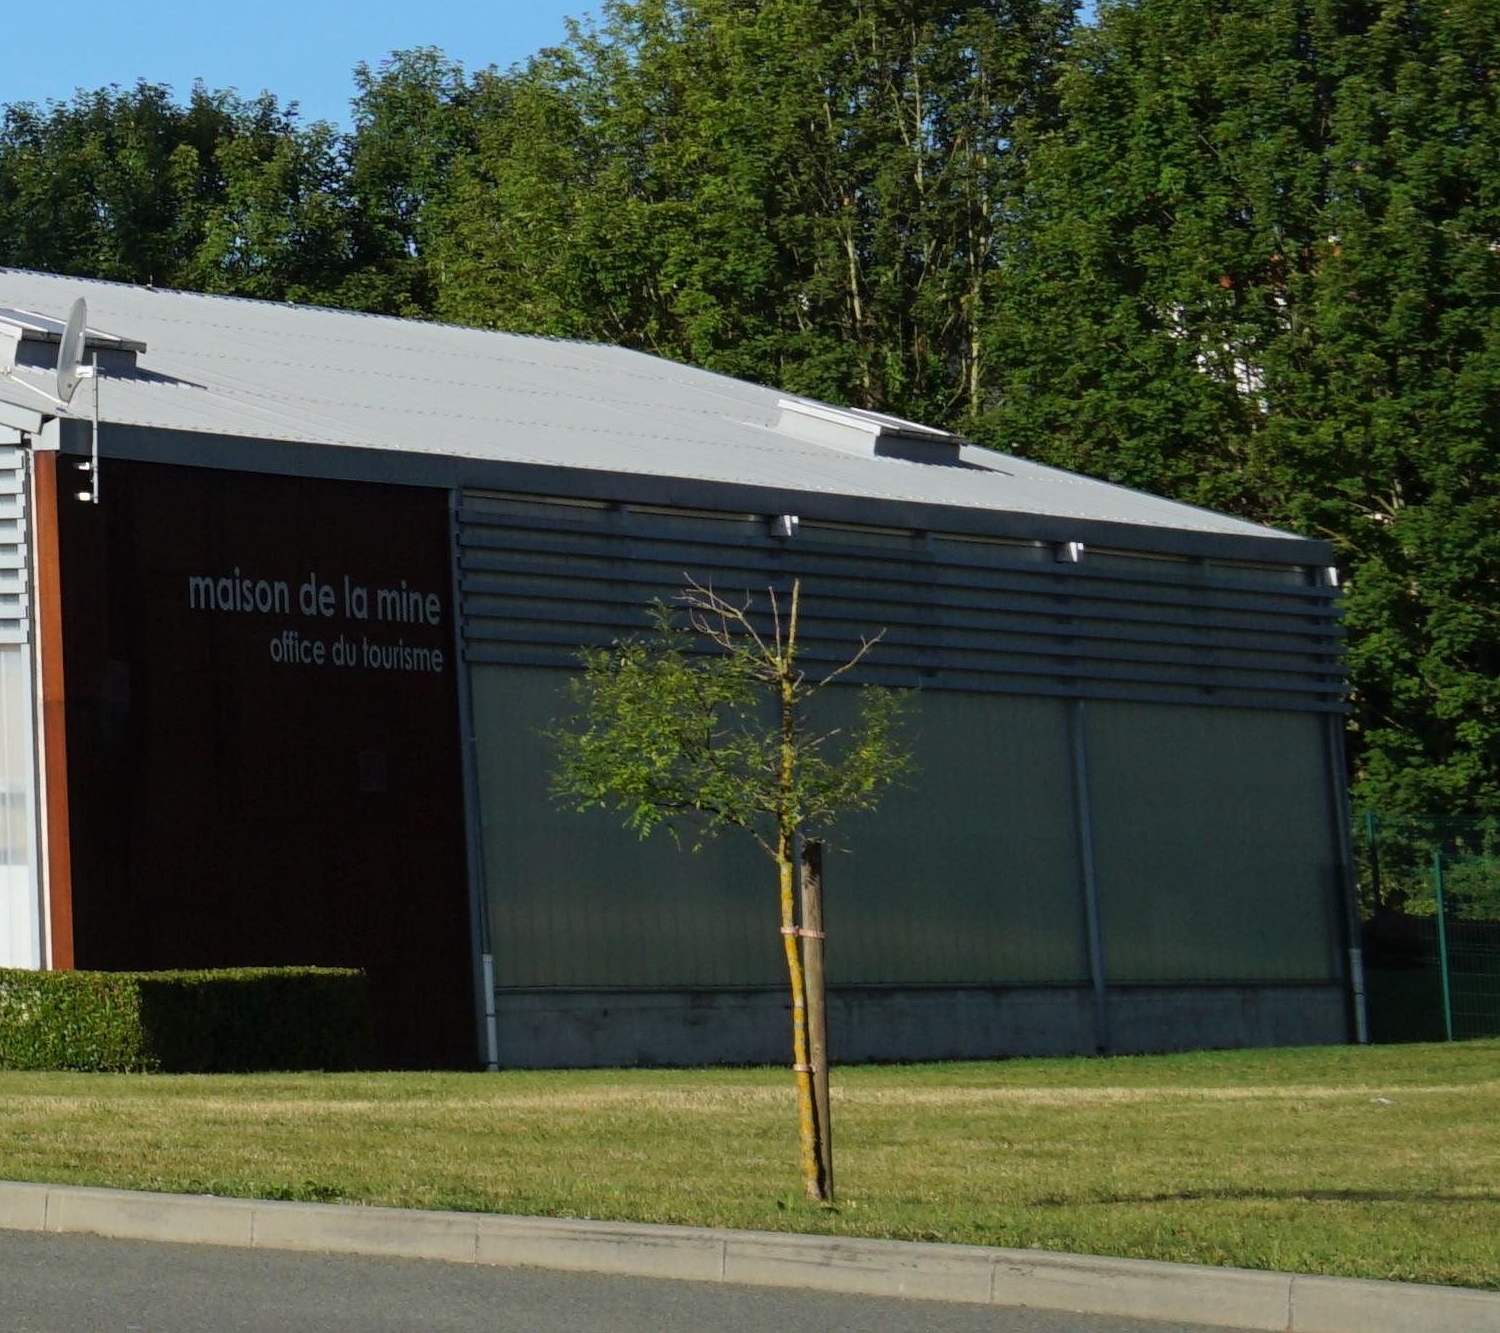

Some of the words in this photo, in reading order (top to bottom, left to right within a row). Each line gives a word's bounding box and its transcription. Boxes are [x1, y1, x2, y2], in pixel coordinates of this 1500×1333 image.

[188, 566, 290, 614] maison
[299, 572, 336, 618] de
[344, 575, 369, 620] la
[377, 580, 442, 625] mine
[270, 629, 326, 665] office
[332, 634, 357, 667] du
[362, 637, 444, 673] tourisme
